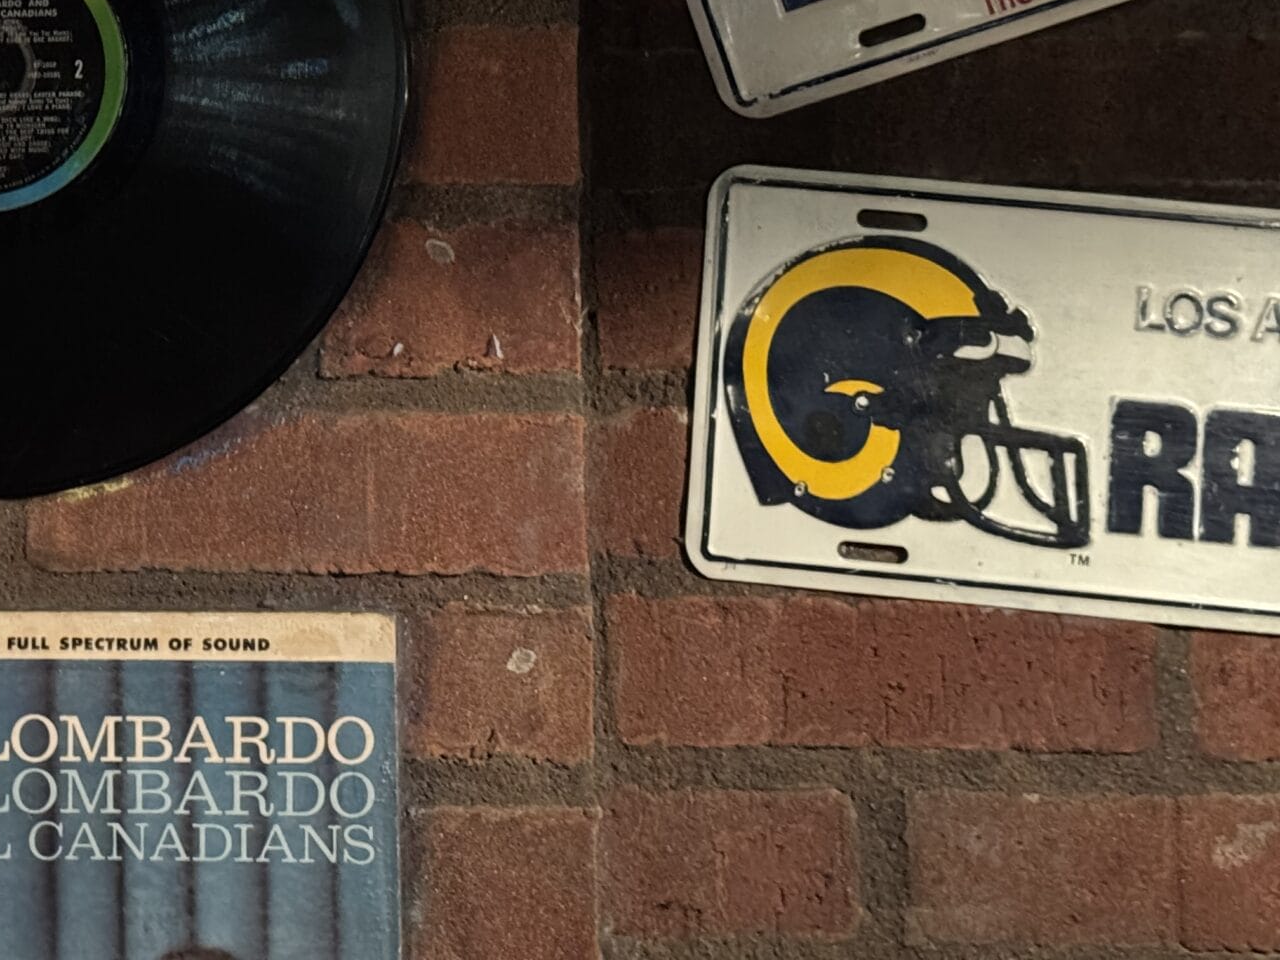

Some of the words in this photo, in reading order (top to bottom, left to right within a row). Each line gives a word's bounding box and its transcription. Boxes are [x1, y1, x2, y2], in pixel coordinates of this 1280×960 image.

[28, 0, 50, 8] AND
[0, 8, 58, 18] CANADIANS
[73, 58, 84, 80] 2
[1133, 285, 1241, 339] LOS
[1070, 553, 1090, 567] TM
[7, 636, 50, 651] FULL
[59, 637, 159, 652] SPECTRUM
[168, 637, 193, 652] OF
[202, 637, 271, 652] SOUND
[28, 820, 376, 865] CANADIANS
